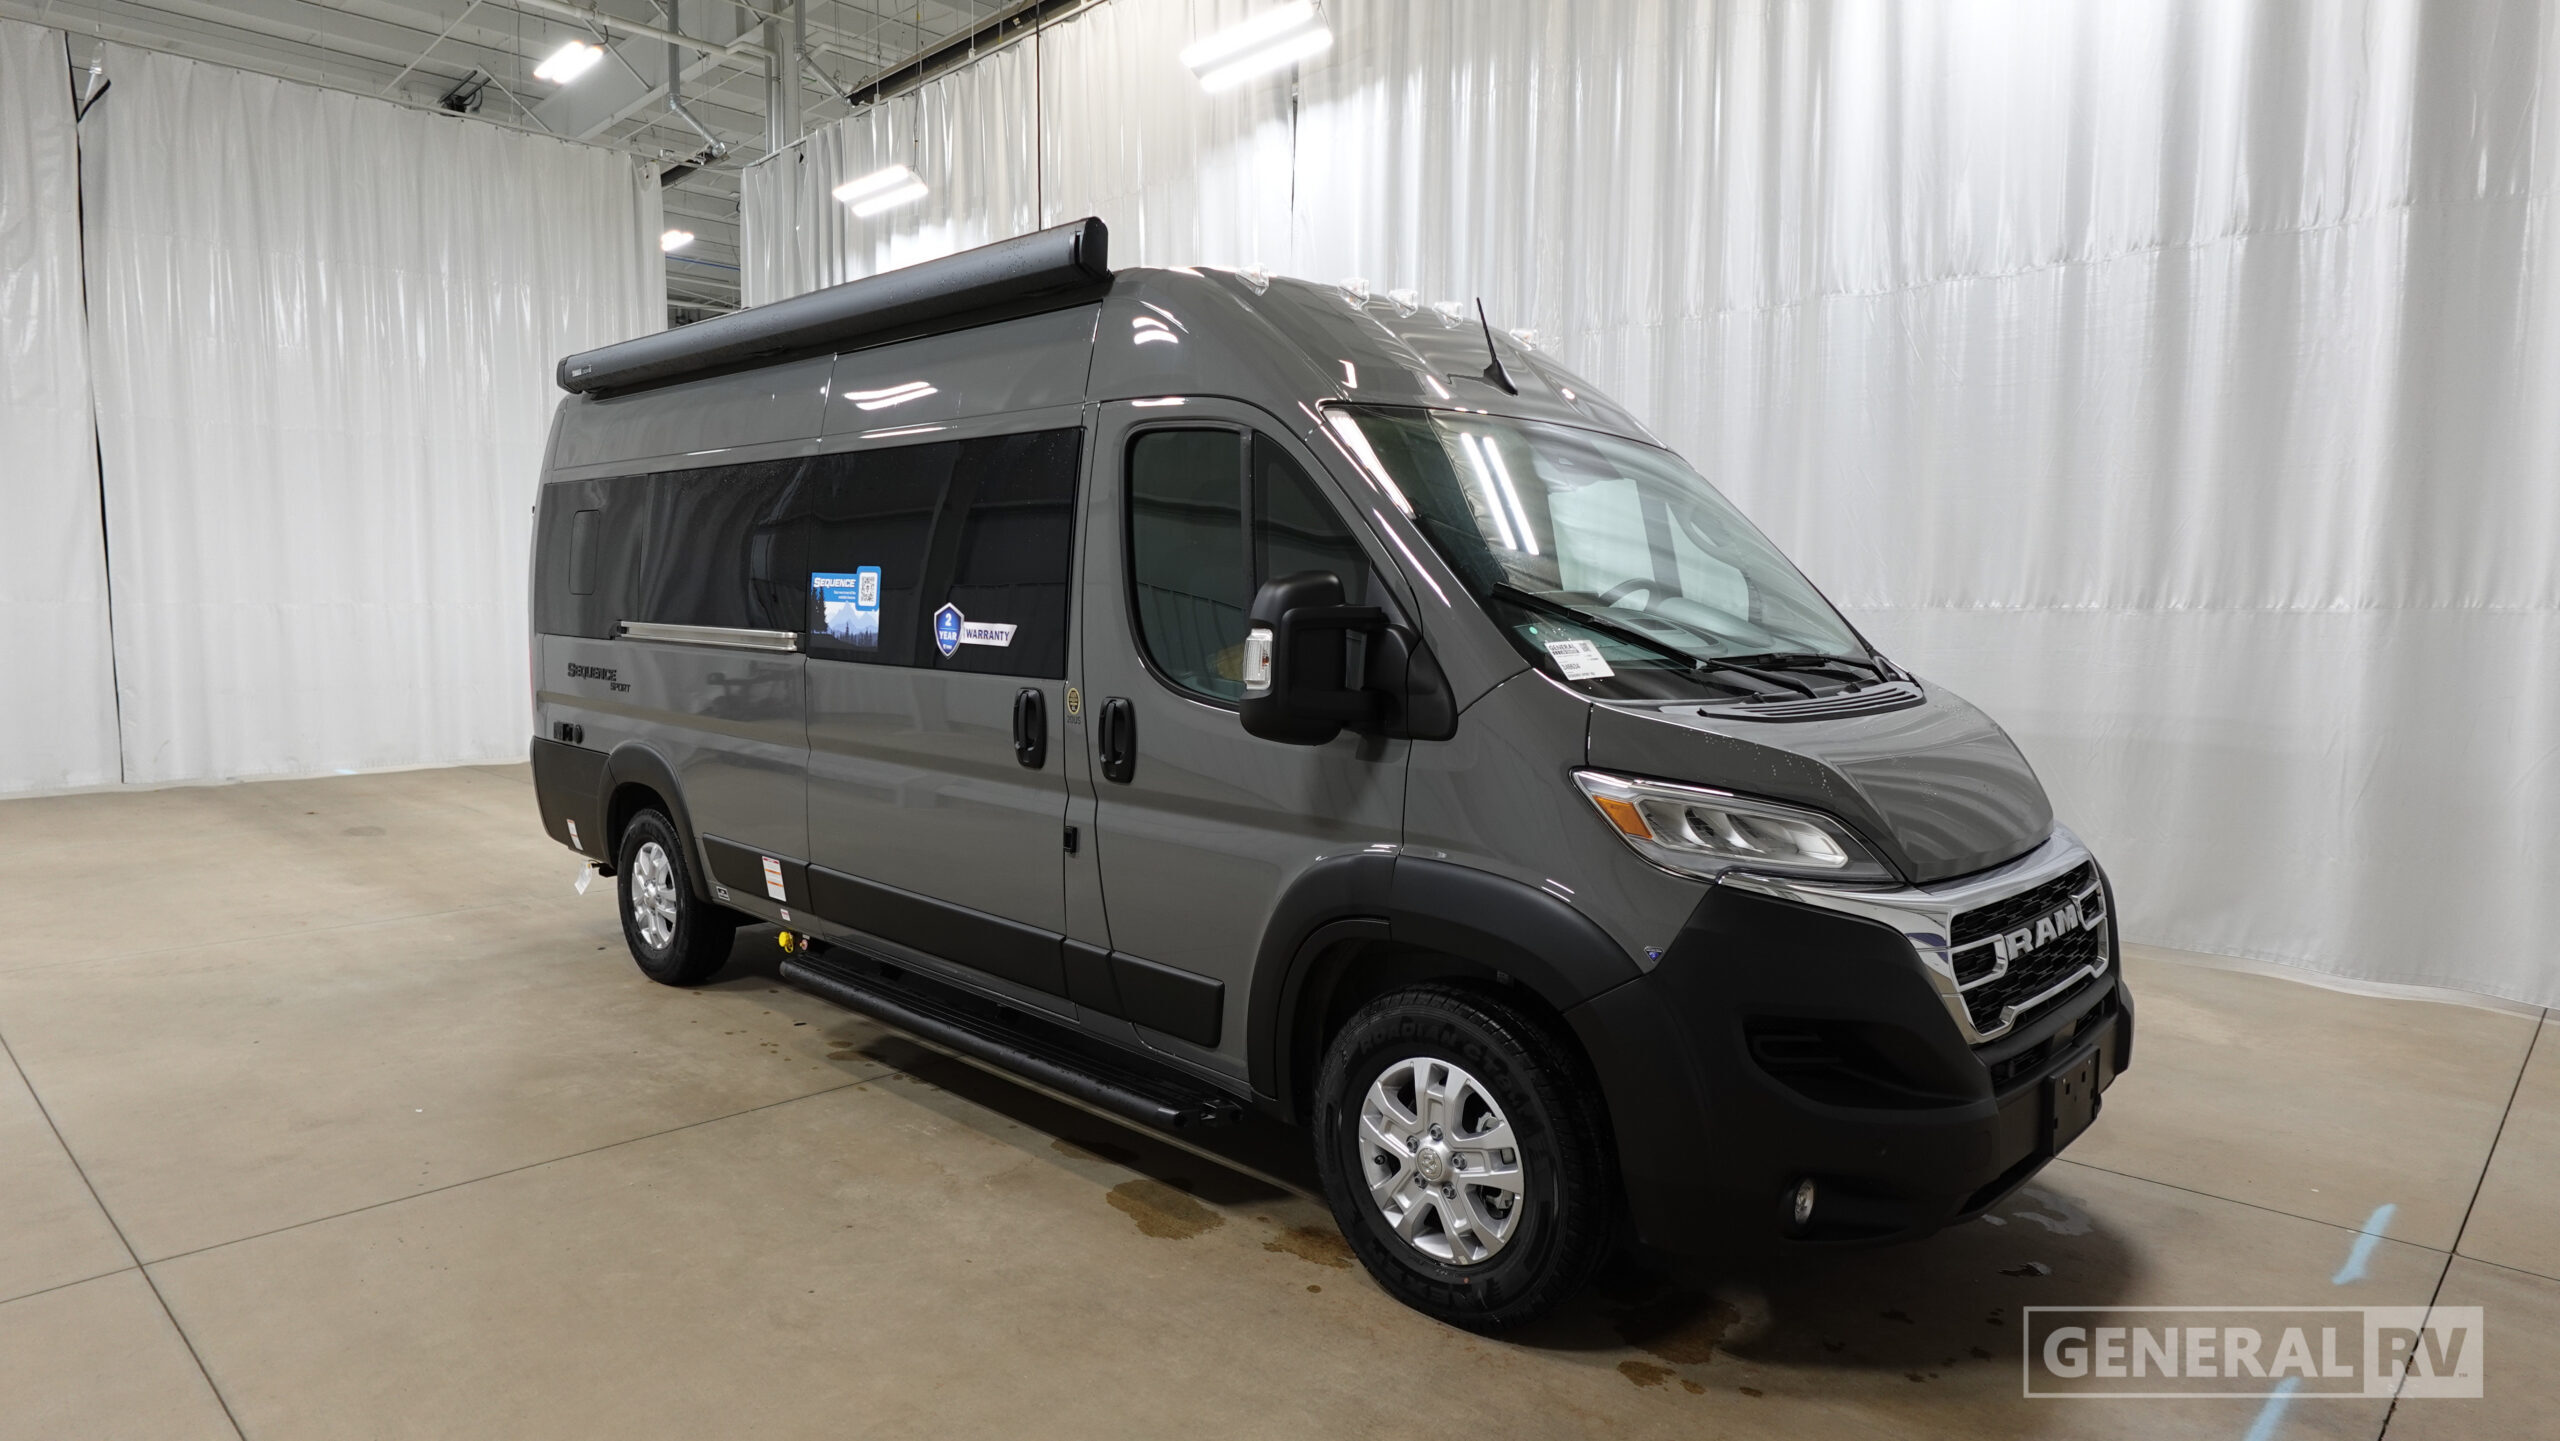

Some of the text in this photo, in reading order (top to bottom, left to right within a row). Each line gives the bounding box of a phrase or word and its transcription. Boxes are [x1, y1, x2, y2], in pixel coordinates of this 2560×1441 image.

[813, 577, 857, 588] SEQUENCE
[944, 612, 952, 627] 2
[939, 630, 957, 640] YEAR
[966, 628, 1010, 641] WARRANTY
[610, 682, 631, 692] SPORT
[2004, 903, 2079, 961] RAM
